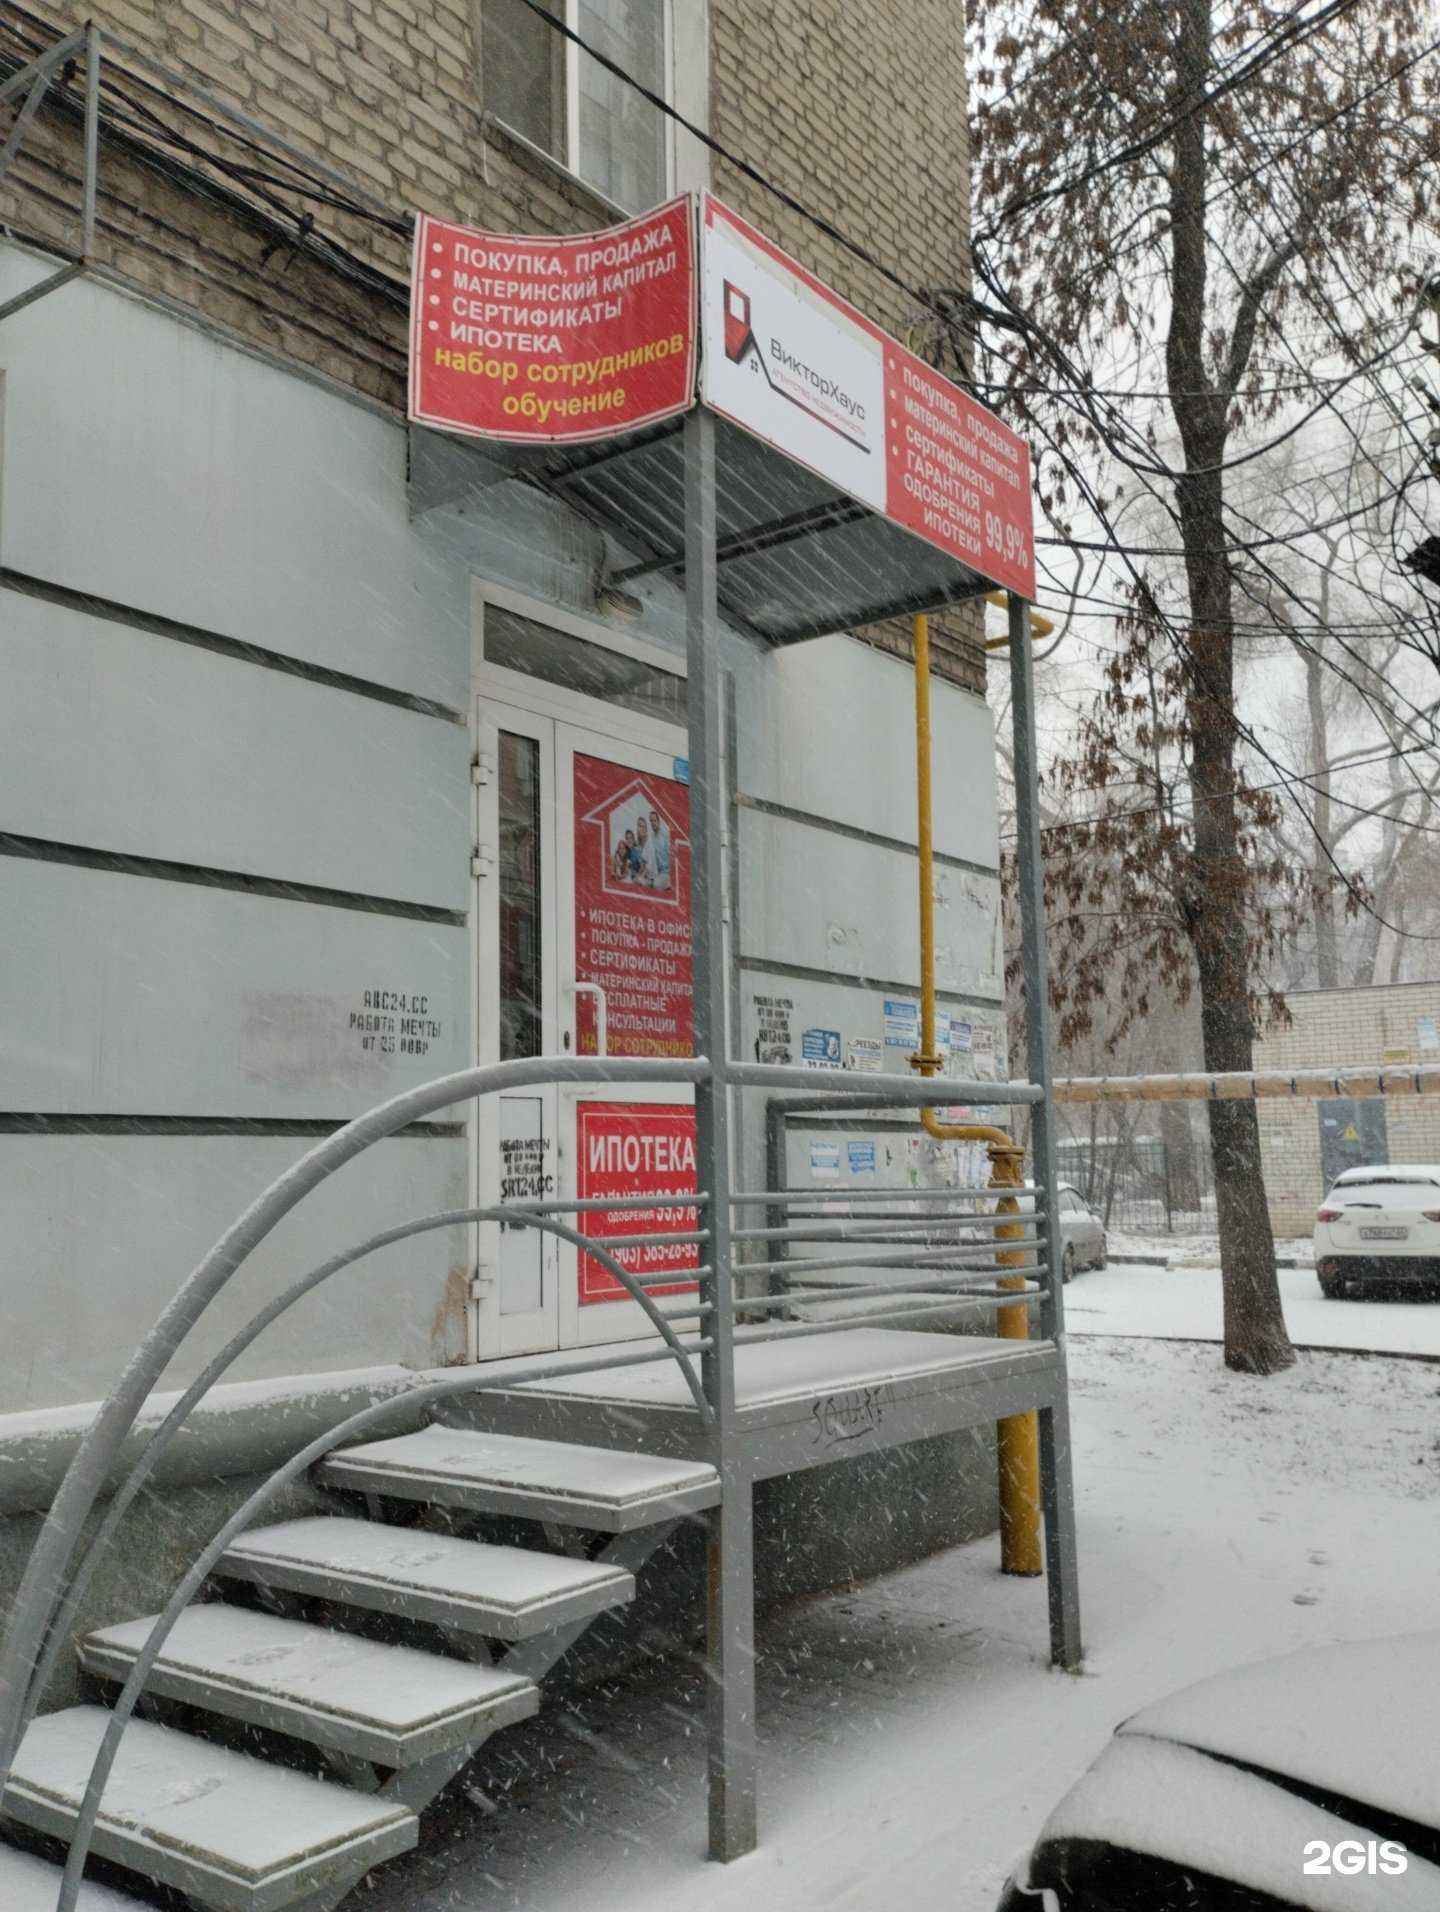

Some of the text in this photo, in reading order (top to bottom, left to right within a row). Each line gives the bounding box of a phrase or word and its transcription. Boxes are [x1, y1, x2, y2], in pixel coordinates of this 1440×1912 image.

[454, 224, 673, 277] ПОКУПКА, ПРОДАЖА
[453, 251, 676, 302] МАТЕРИНСКИЙ КАПИТАЛ
[453, 295, 622, 328] СЕРТИФИКАТЫ
[434, 334, 685, 386] набор сотрудников
[450, 321, 562, 354] ИПОТЕКА
[770, 337, 865, 421] ВикторХаус
[503, 387, 625, 423] обучение
[904, 396, 978, 460] материнский
[980, 448, 1020, 490] капитал
[905, 424, 994, 498] сертификаты
[967, 413, 1018, 464] продажа
[907, 449, 980, 512] ГАРАНТИЯ
[903, 472, 1028, 570] ОДОБРЕНИЯ 99,9%
[923, 507, 981, 557] ИПОТЕКИ
[589, 908, 645, 931] ИПОТЕКА
[647, 919, 655, 933] В
[591, 928, 640, 949] ПОКУПКА
[590, 948, 676, 974] СЕРТИФИКАТЫ
[590, 1135, 696, 1173] ИПОТЕКА
